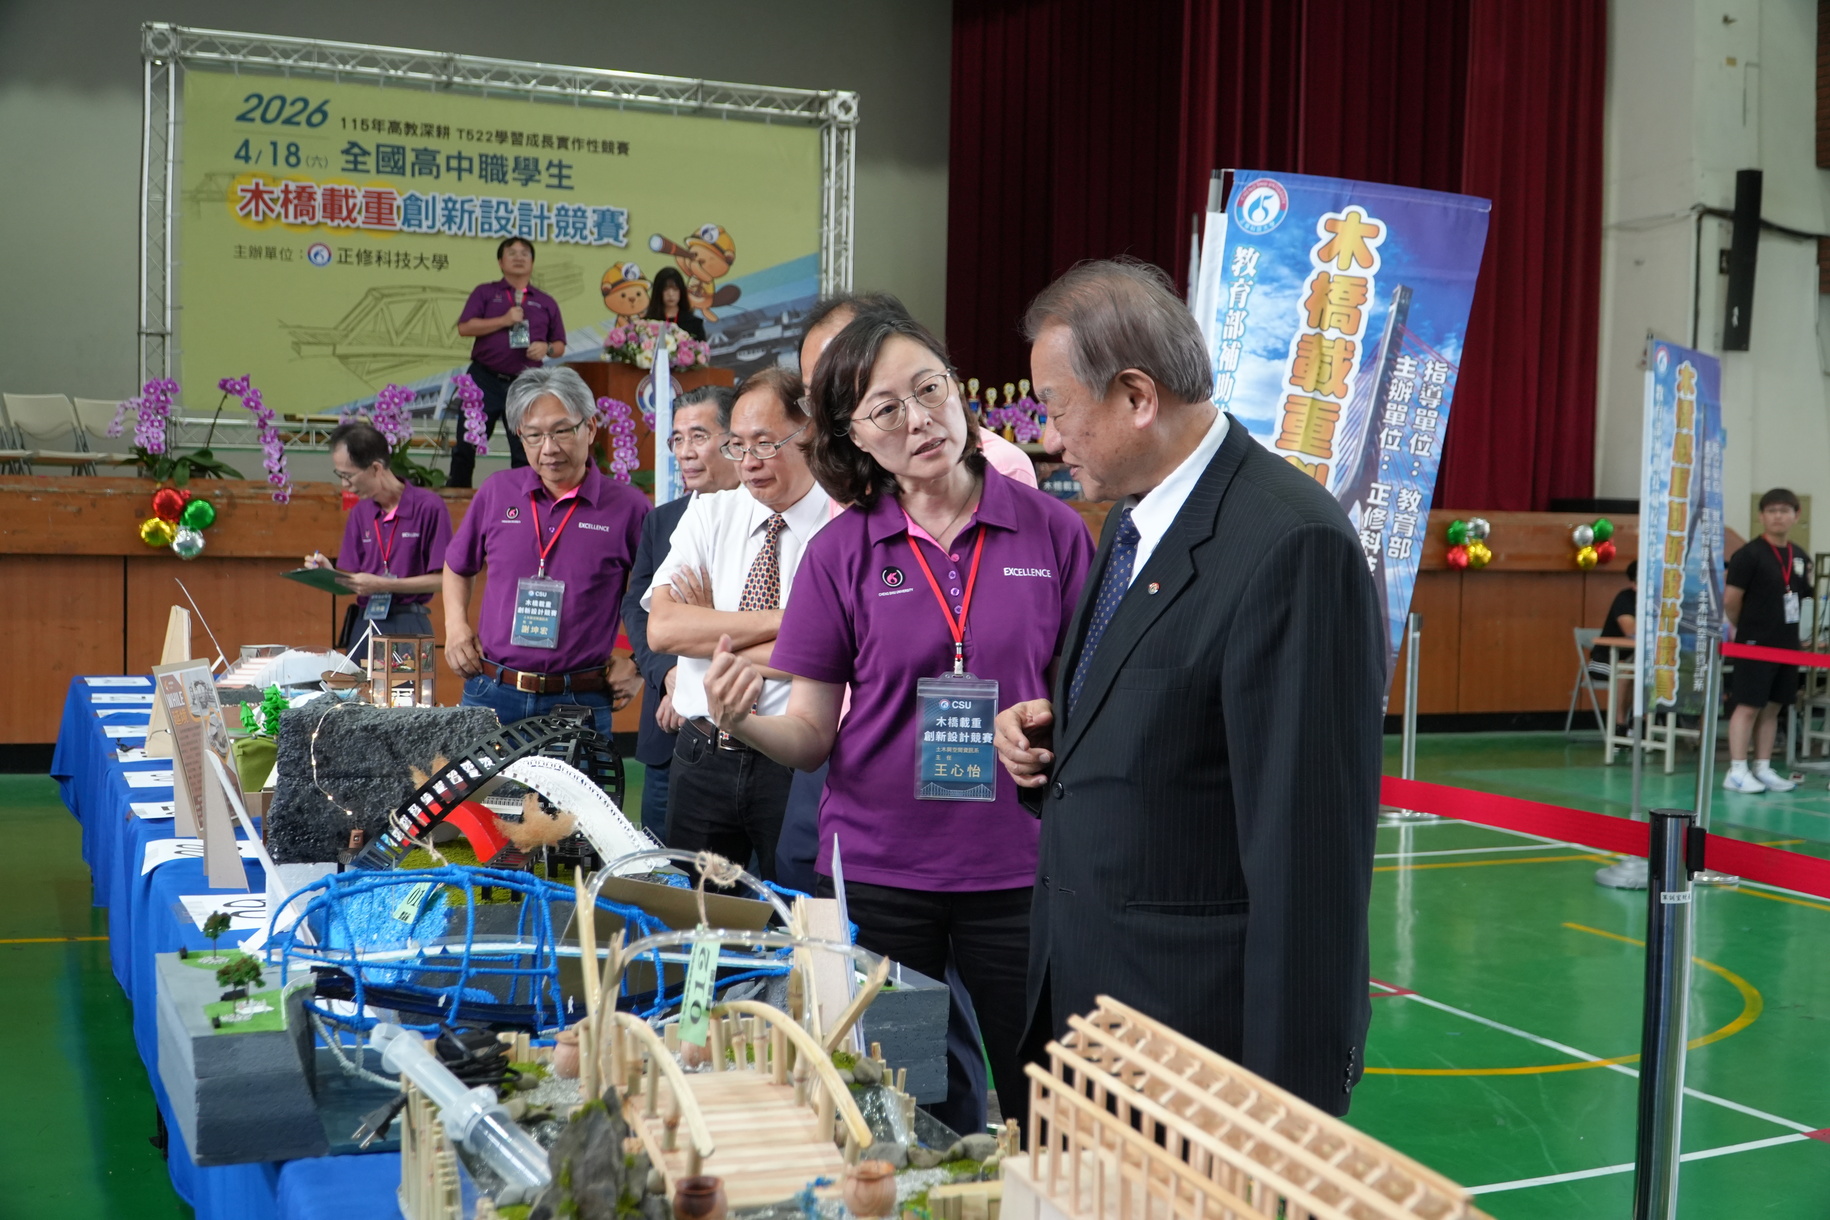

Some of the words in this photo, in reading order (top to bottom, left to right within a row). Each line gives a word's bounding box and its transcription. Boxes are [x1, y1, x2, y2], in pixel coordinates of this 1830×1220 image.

[235, 93, 330, 128] 2026
[340, 116, 450, 141] 115年高教深耕
[456, 128, 630, 157] T522學習成長實作性競賽
[340, 141, 575, 191] 全國高中職學生
[238, 180, 629, 248] 木橋載重創新設計競賽
[336, 246, 450, 272] 正修科技大學
[1212, 246, 1261, 411] 教育部補助
[578, 522, 609, 533] EXCELLENCE
[1387, 487, 1423, 560] 教育部
[1003, 567, 1051, 578] EXCELLENCE
[936, 716, 982, 728] 木橋載重
[952, 701, 972, 709] CSU
[924, 731, 993, 743] 創新設計競賽
[690, 947, 710, 1024] 012
